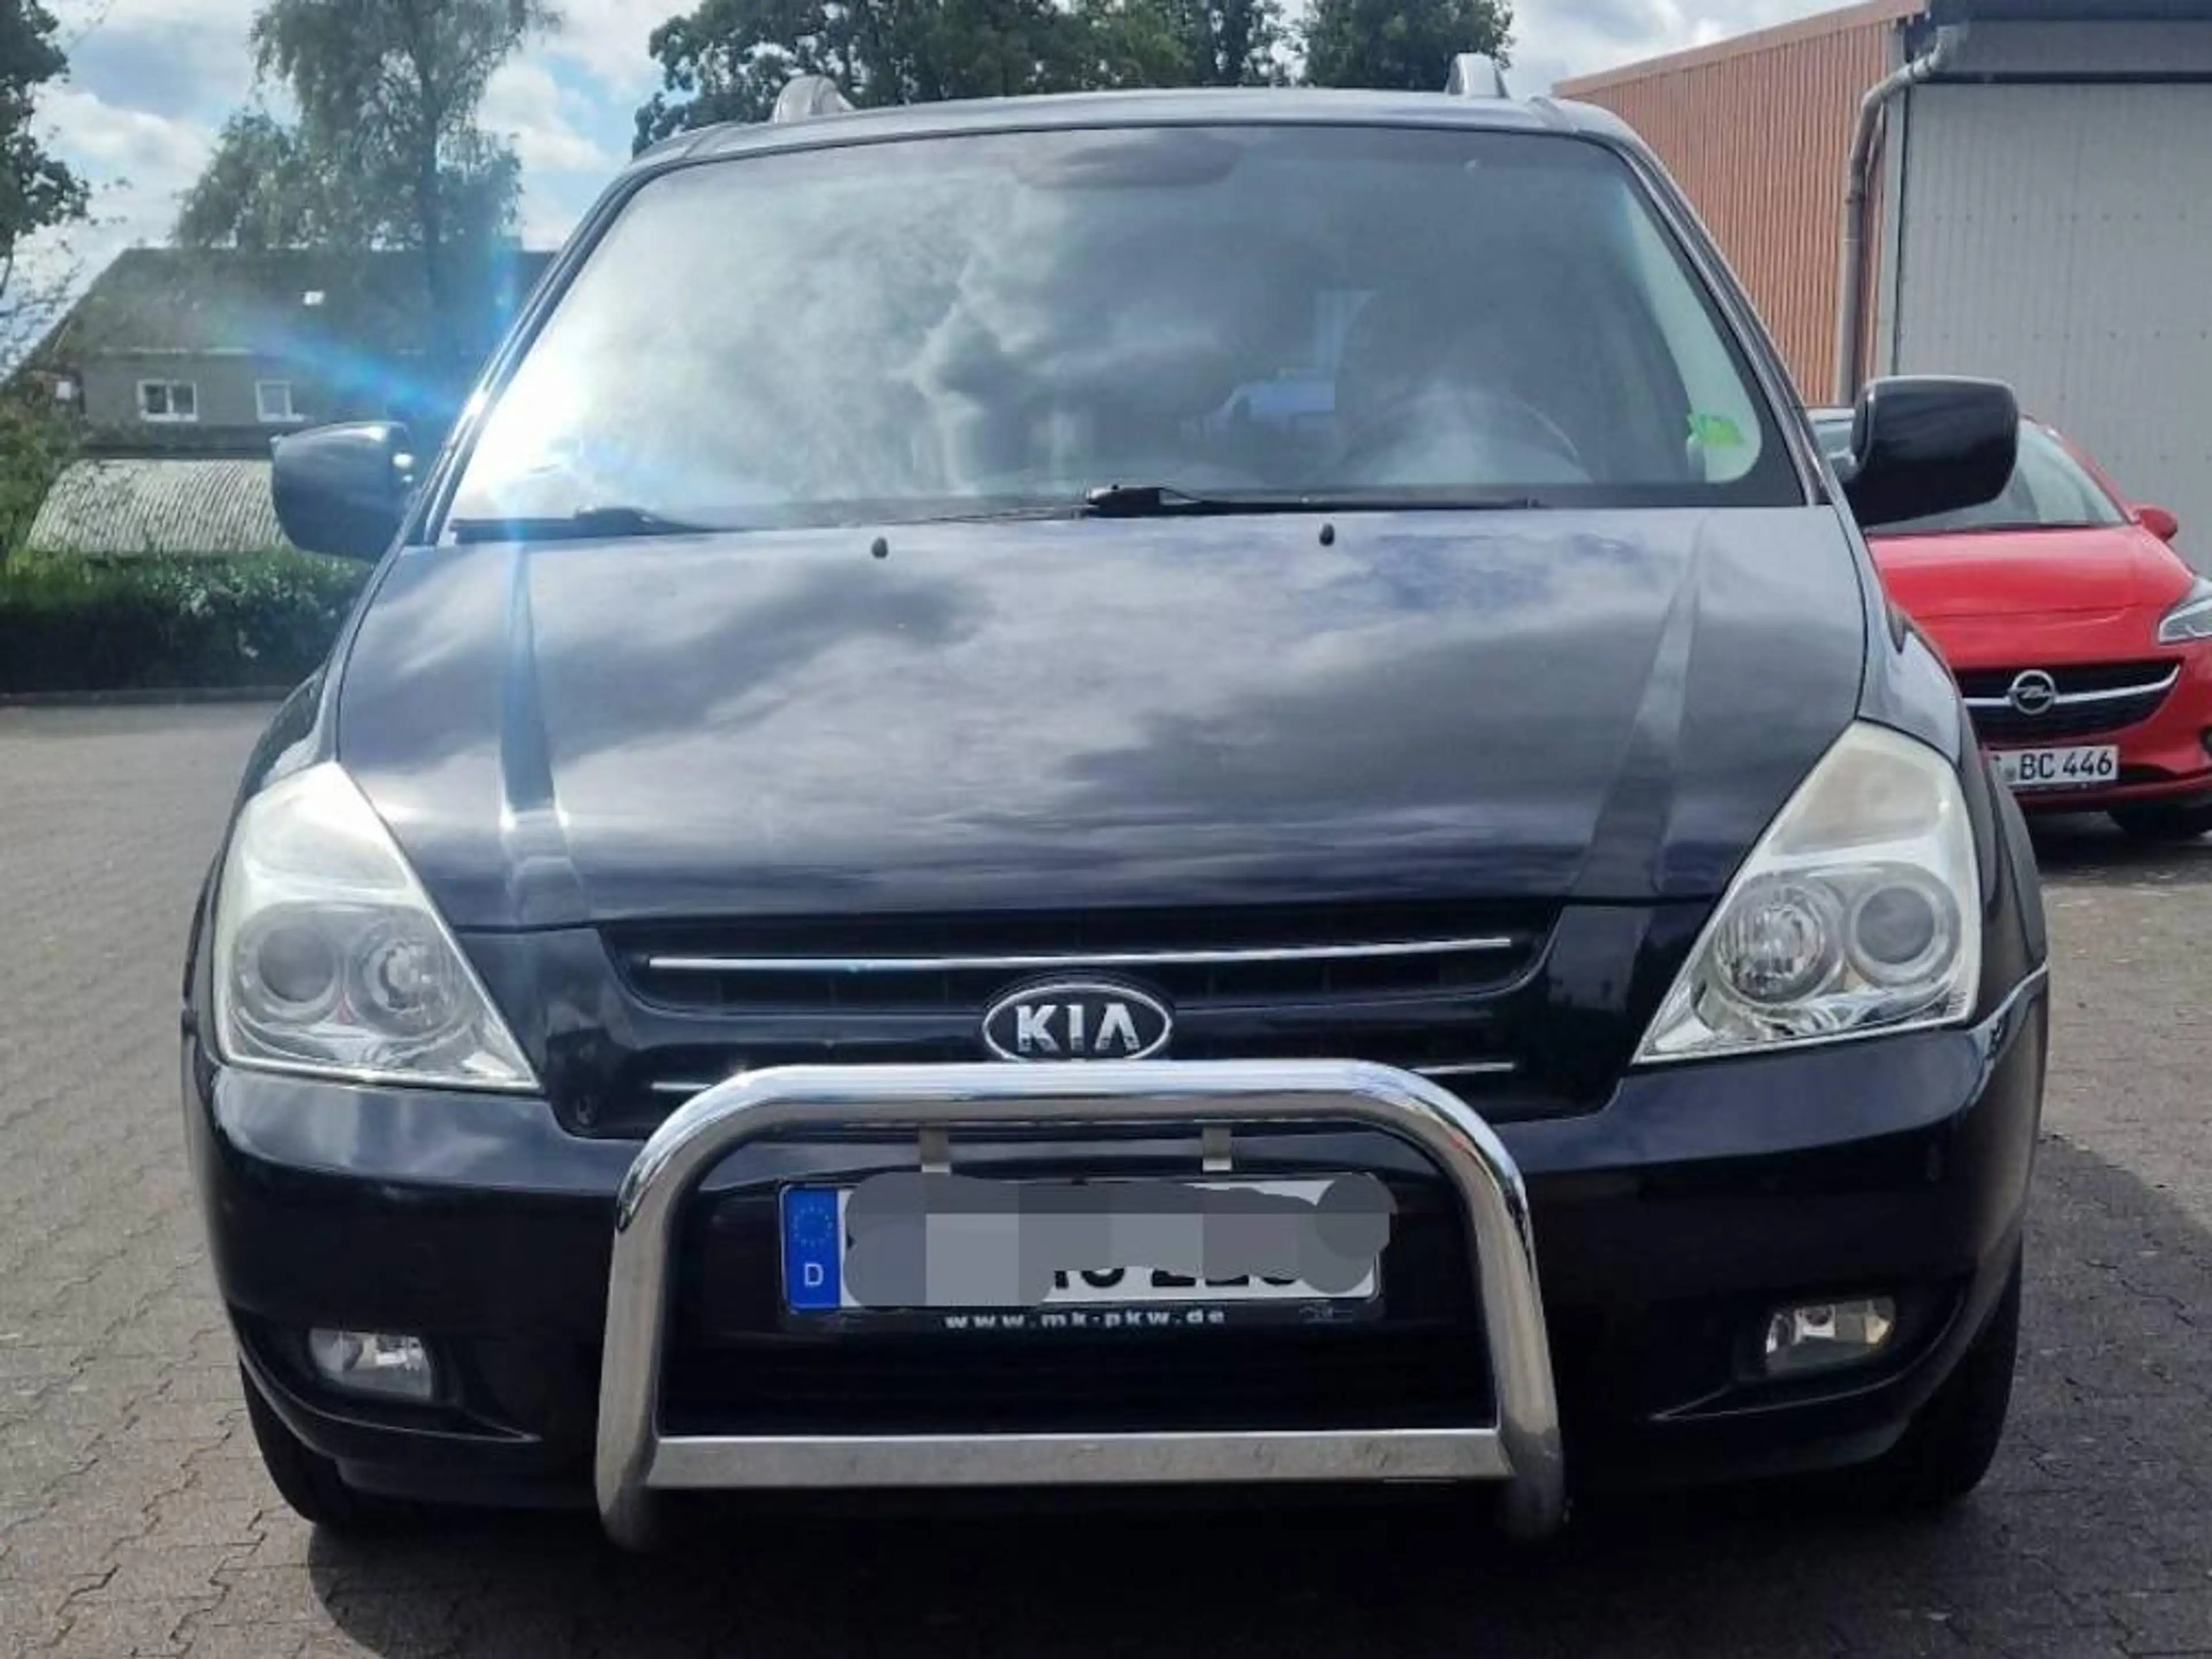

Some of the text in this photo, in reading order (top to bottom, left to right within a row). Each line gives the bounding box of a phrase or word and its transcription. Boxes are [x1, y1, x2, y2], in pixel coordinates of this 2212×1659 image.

[2019, 751, 2112, 779] BC 446
[1015, 1002, 1141, 1052] KIA
[804, 1263, 824, 1287] D
[945, 1309, 1225, 1328] www.mk-pkw.de
